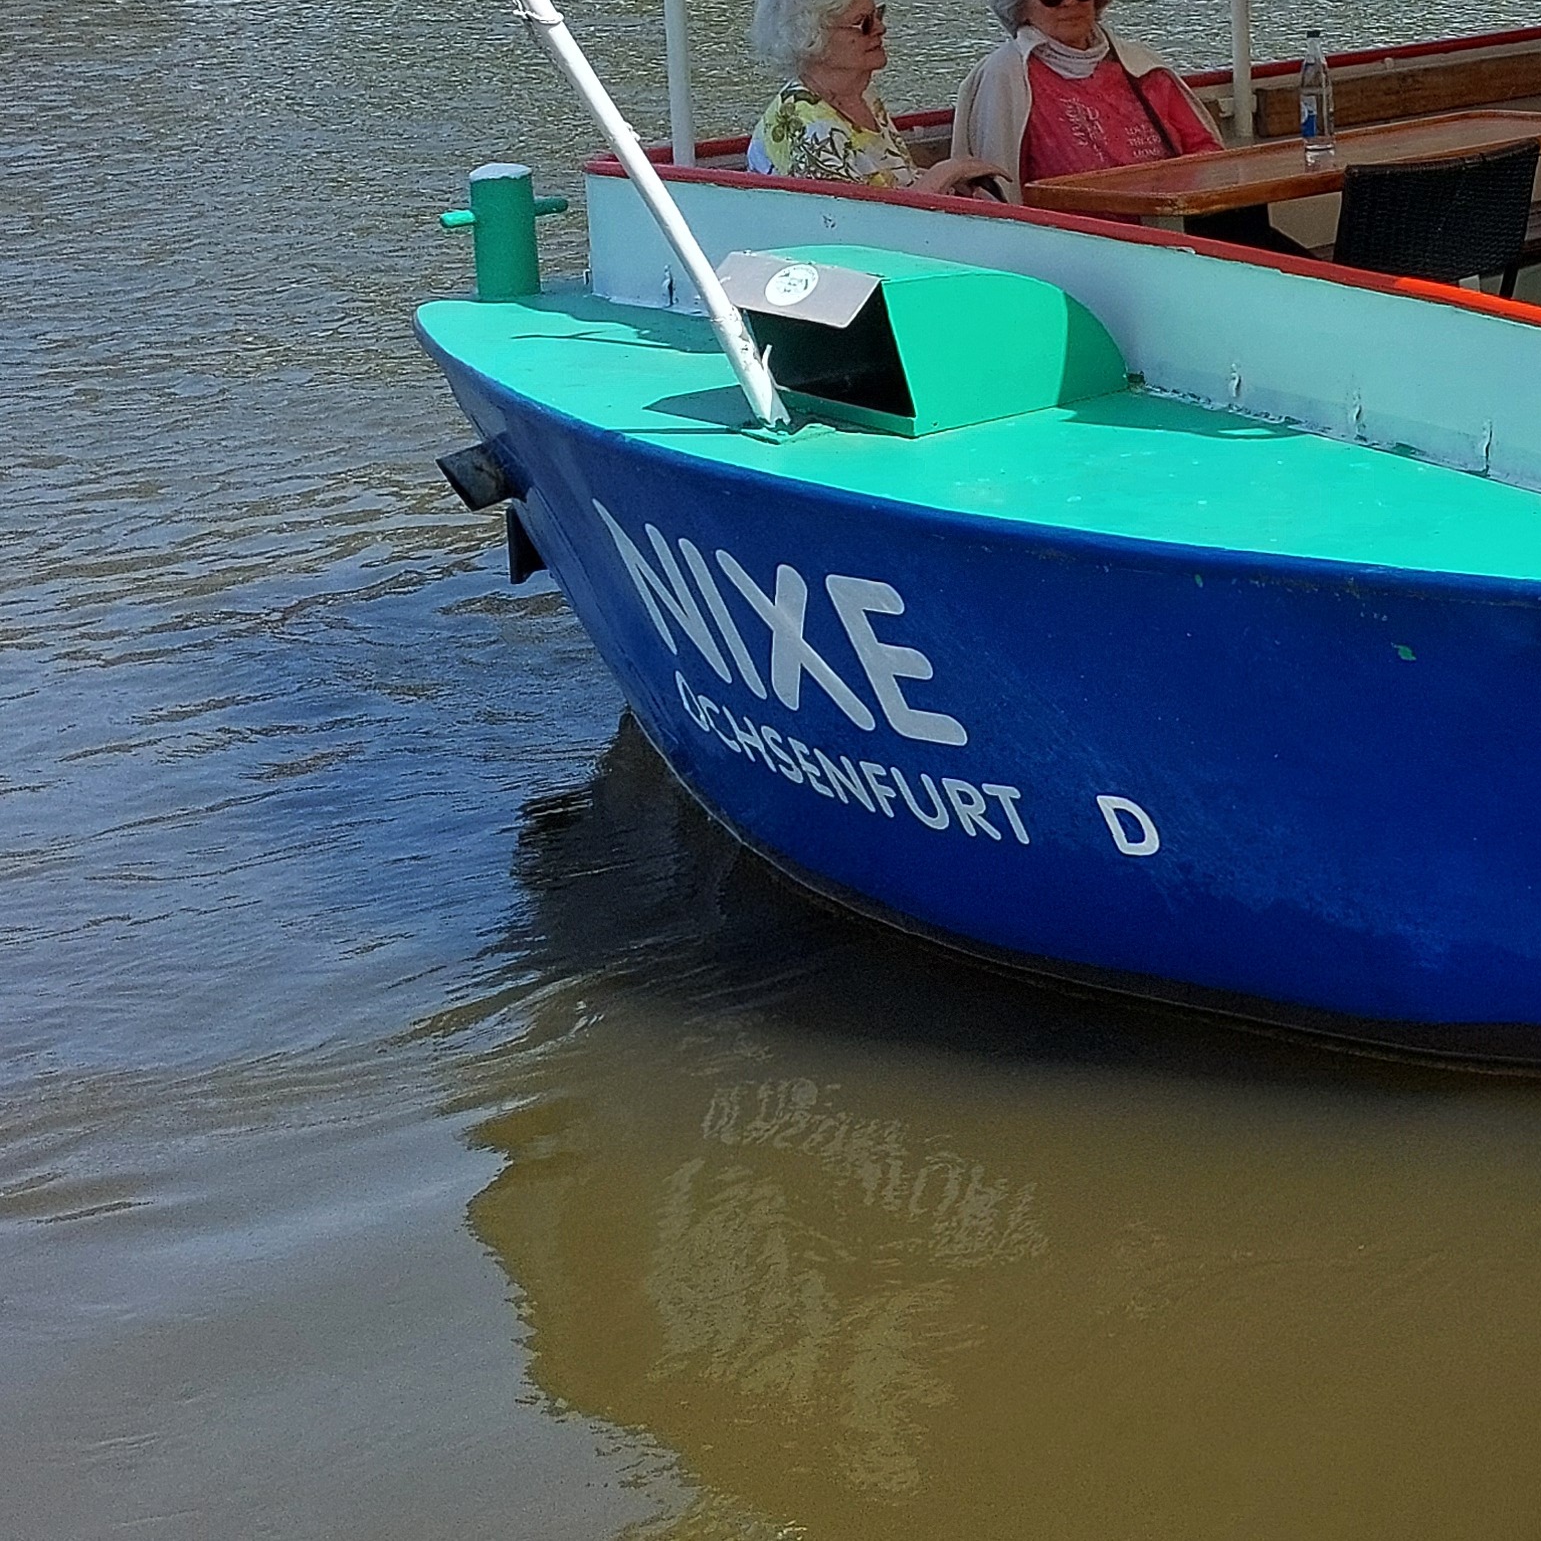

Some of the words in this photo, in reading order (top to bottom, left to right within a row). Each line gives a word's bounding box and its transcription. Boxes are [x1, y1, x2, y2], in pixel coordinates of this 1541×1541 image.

[592, 497, 968, 747] NIXE
[675, 670, 1030, 845] OCHSENFURT
[1096, 794, 1160, 856] D
